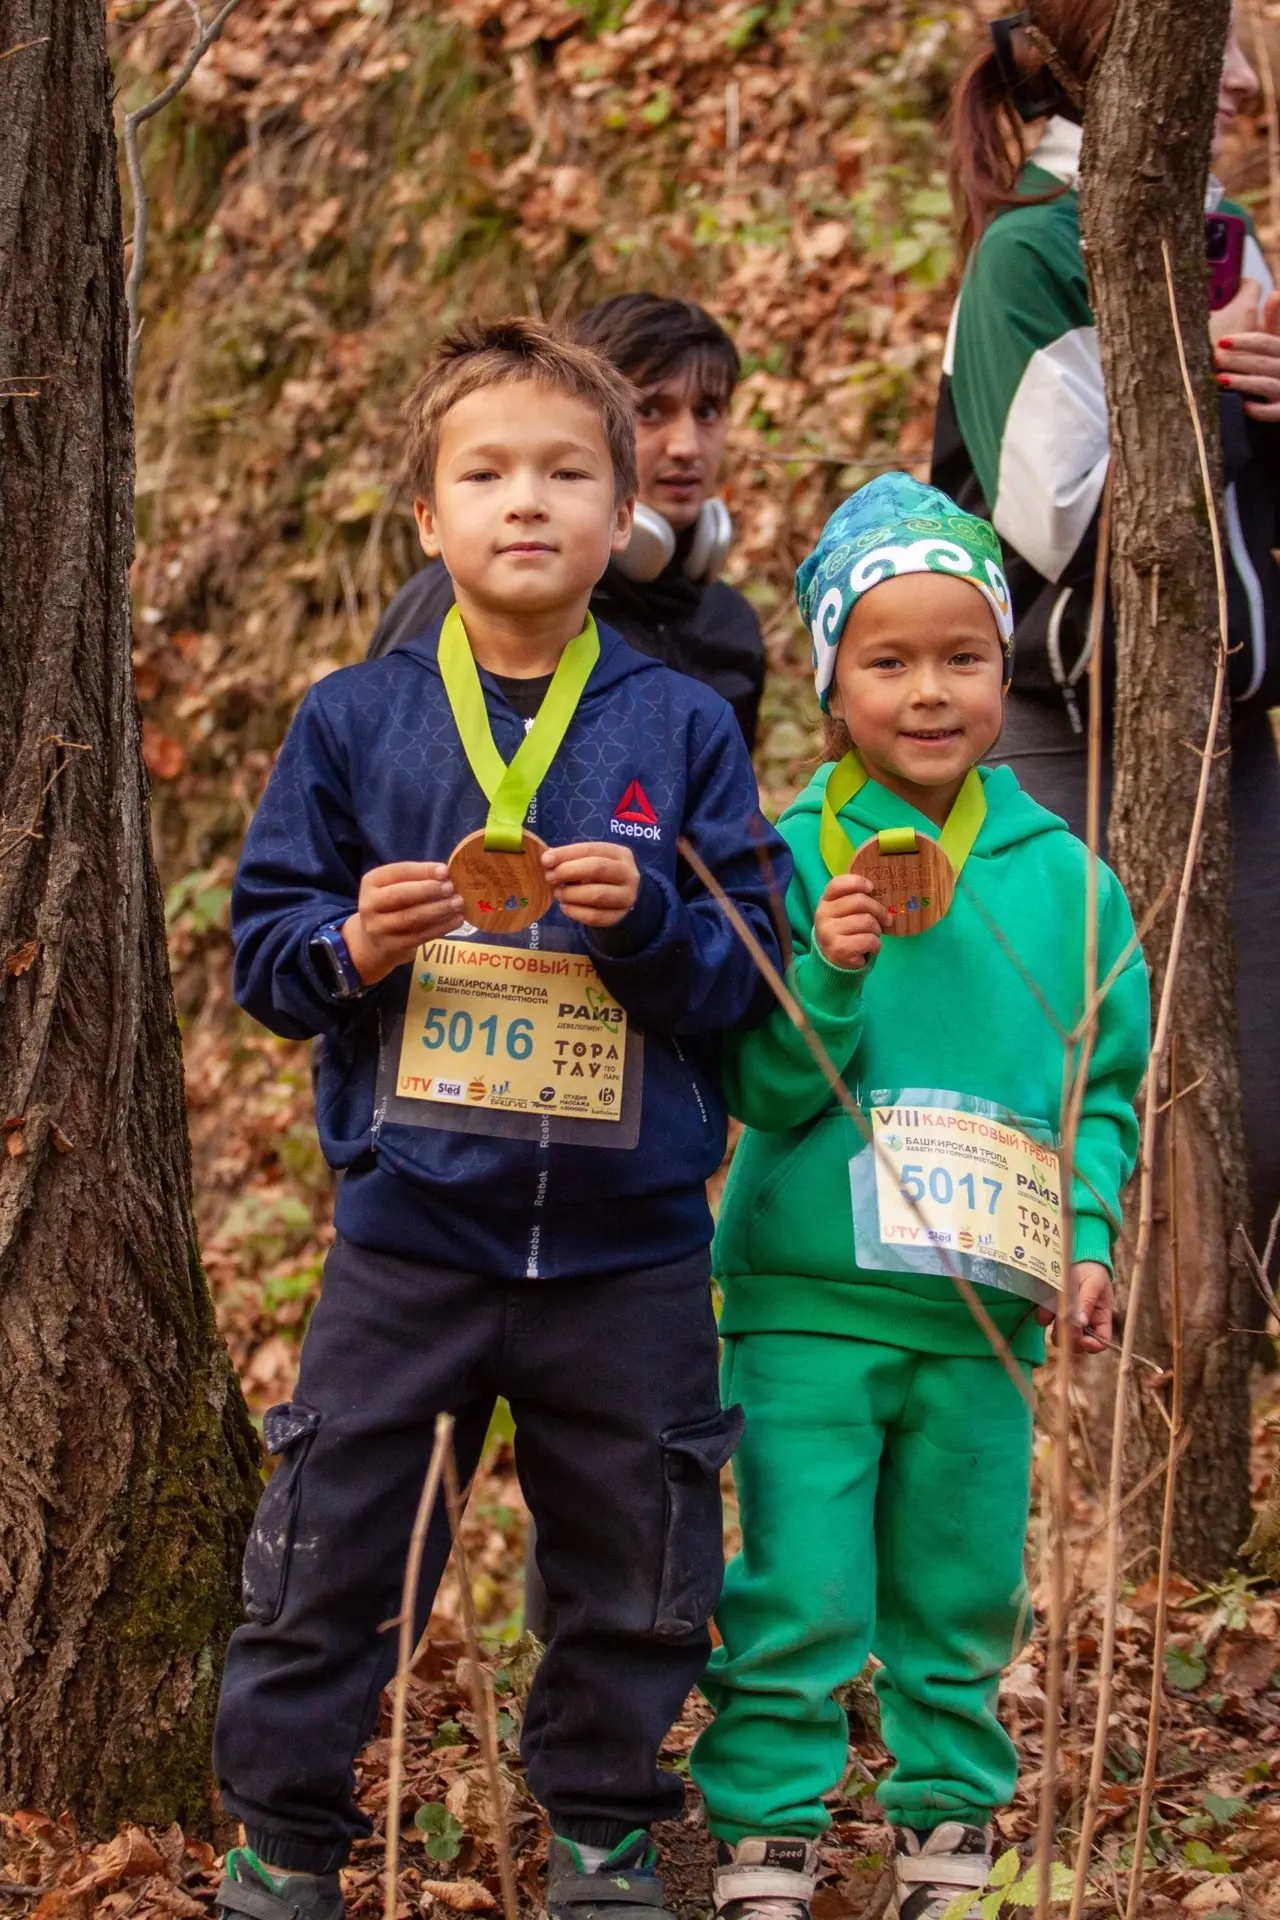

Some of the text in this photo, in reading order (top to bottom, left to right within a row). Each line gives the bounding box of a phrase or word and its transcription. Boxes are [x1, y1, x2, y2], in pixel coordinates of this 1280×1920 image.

[422, 944, 456, 965] VIII
[457, 950, 570, 976] КАРСТОВЫЙ
[436, 986, 459, 994] ЗАБЕГИ
[472, 991, 500, 999] ГОРНОЙ
[501, 994, 548, 1005] МЕСТНОСТИ
[437, 976, 548, 997] БАШКИРСКАЯ ТРОПА
[422, 1007, 535, 1060] 5016
[557, 1022, 603, 1033] ДЕВЕЛОПМЕНТ
[554, 1040, 619, 1060] ТОРА
[401, 1076, 432, 1092] UTV
[604, 1073, 620, 1081] ПАРК
[438, 1083, 461, 1096] Sled
[876, 1110, 919, 1127] VIII
[922, 1114, 1019, 1150] КАРСТОВЫЙ
[906, 1136, 1008, 1165] БАШКИРСКАЯ ТРОПА
[906, 1145, 933, 1153] ЗАБЕГИ
[946, 1150, 973, 1160] ГОРНОЙ
[901, 1164, 1003, 1215] 5017
[1018, 1205, 1061, 1238] ТОРА
[884, 1224, 921, 1240] UTV
[928, 1230, 952, 1243] Sled
